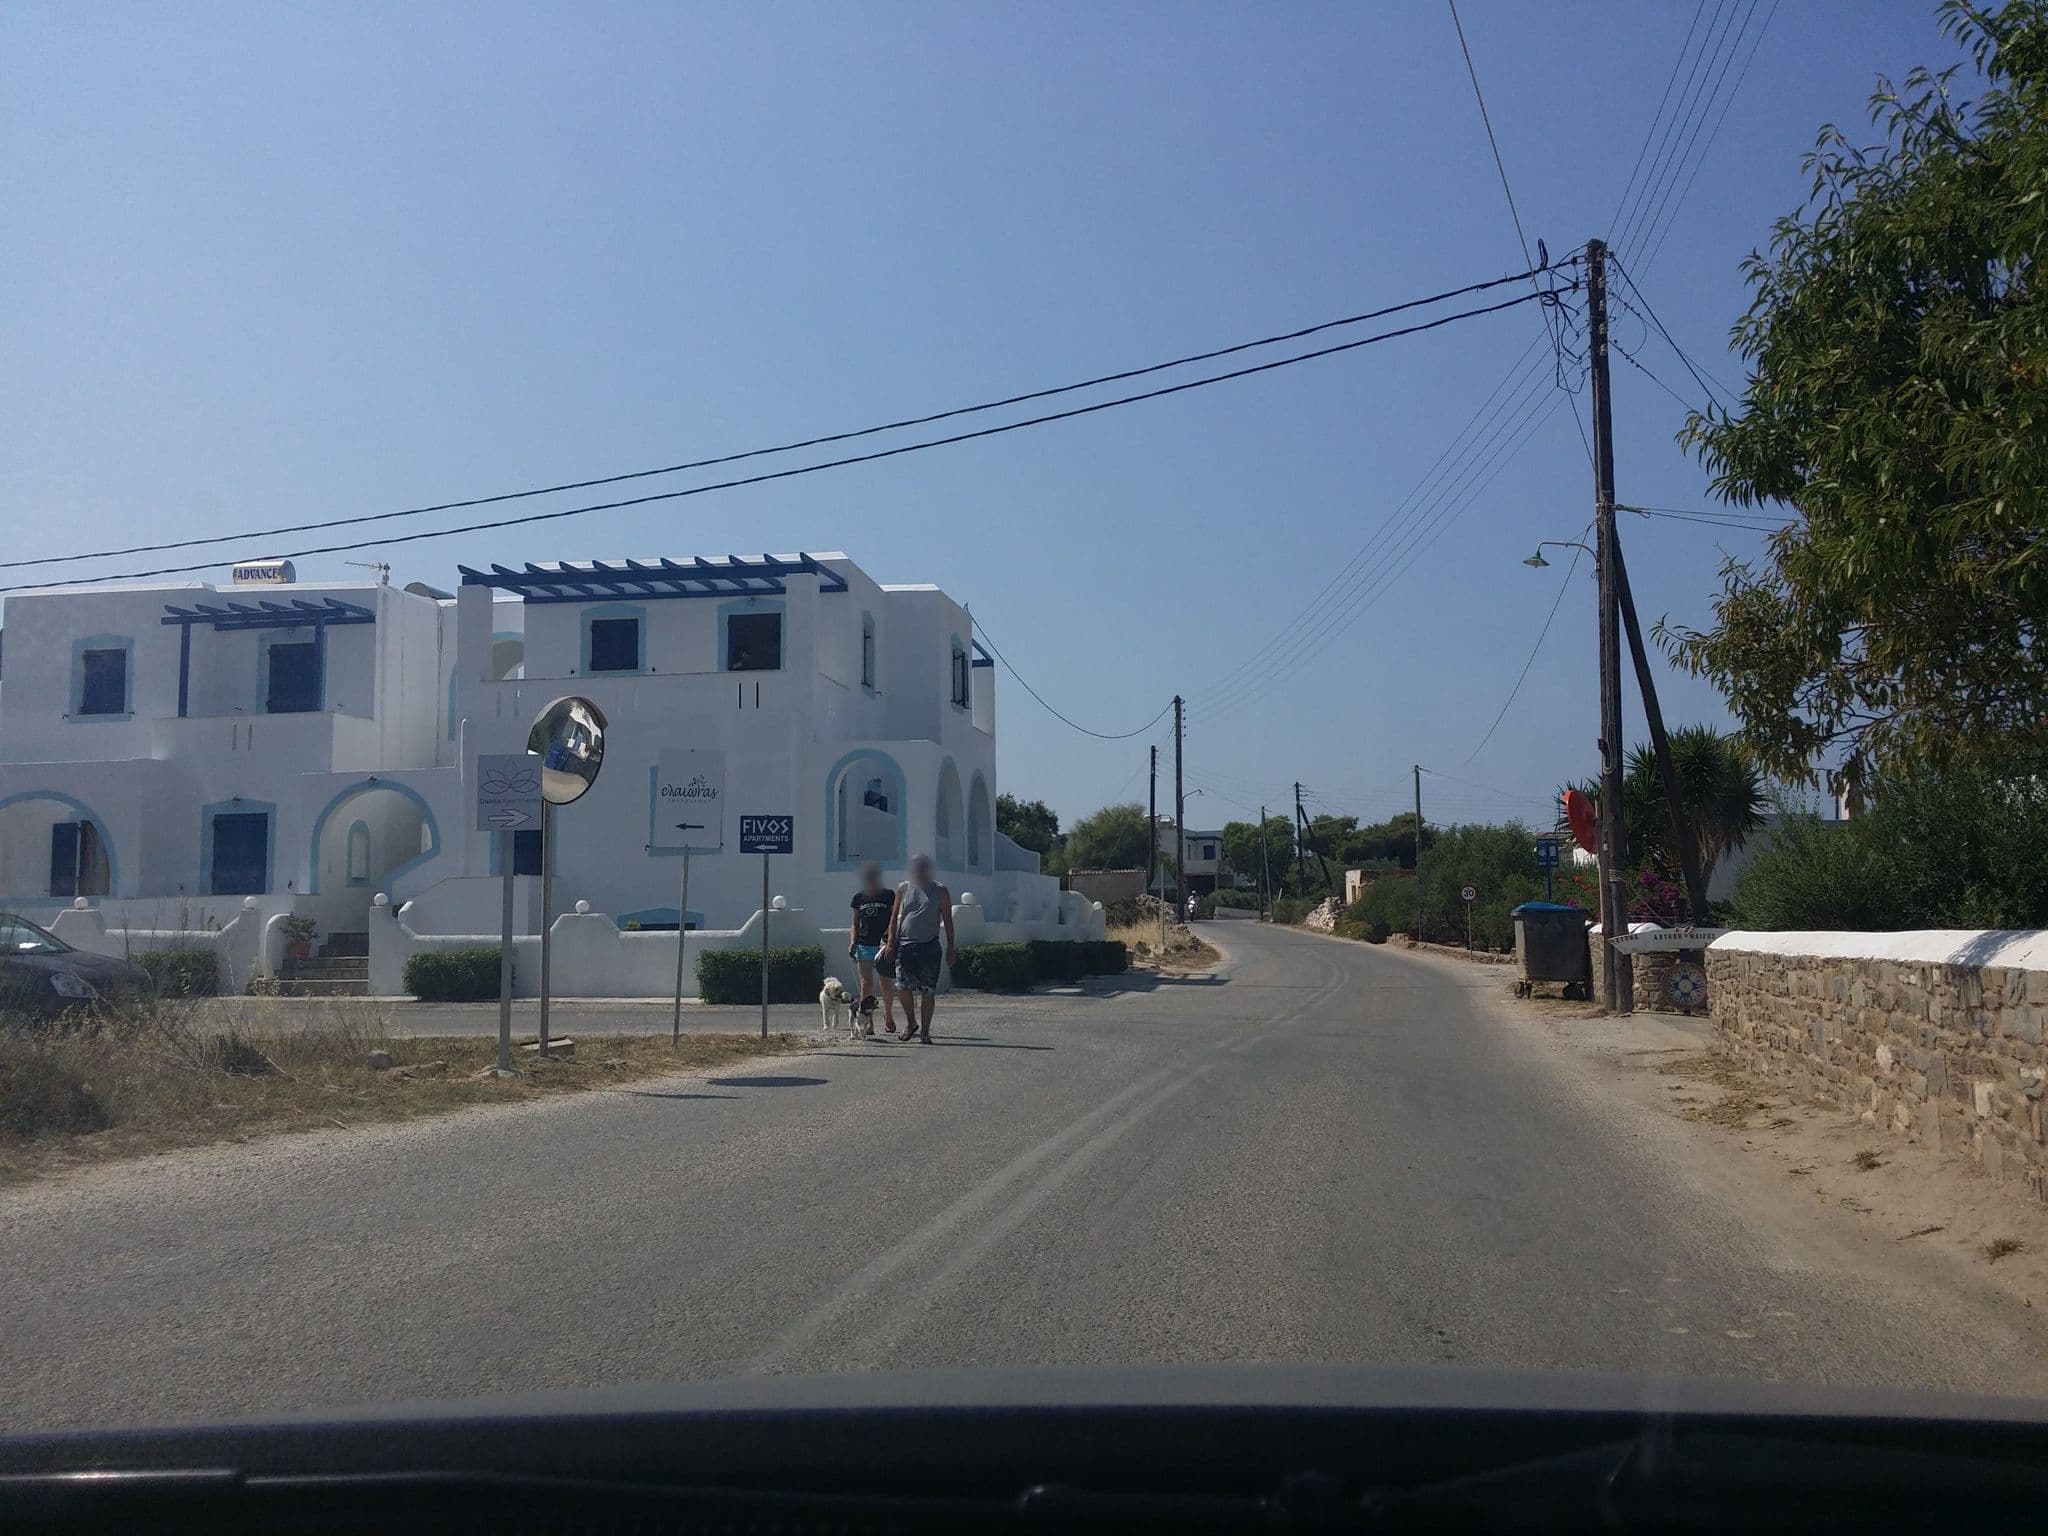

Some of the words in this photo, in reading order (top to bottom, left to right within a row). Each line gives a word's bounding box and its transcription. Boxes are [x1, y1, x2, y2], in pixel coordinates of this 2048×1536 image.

[237, 568, 278, 580] ADVANCE
[743, 819, 789, 834] FIVOS
[1463, 889, 1475, 897] 30
